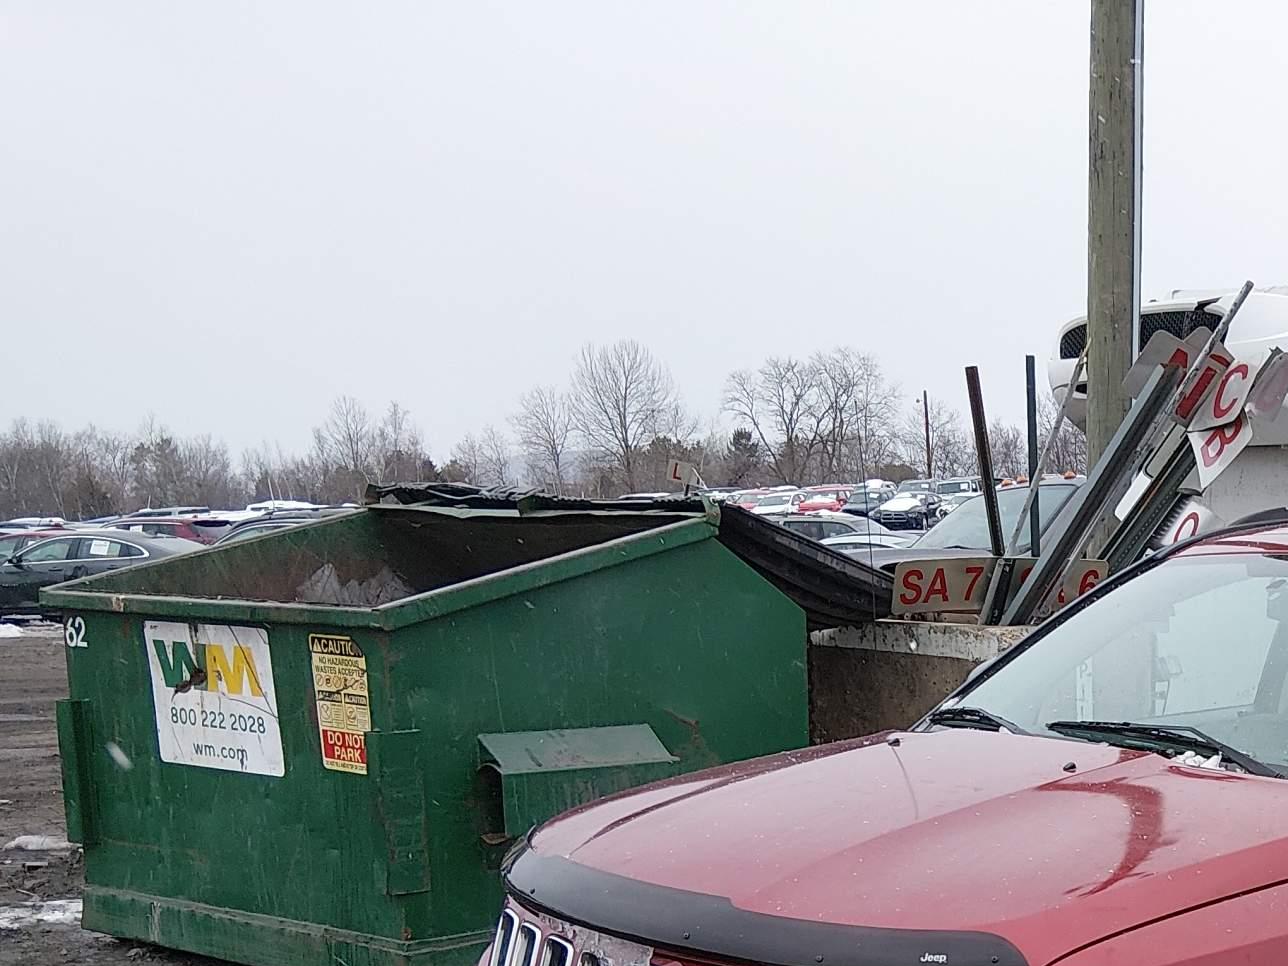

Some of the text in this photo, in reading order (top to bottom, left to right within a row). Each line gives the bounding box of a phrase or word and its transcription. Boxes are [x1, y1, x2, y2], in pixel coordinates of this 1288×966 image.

[1214, 363, 1249, 419] C
[900, 568, 949, 605] SA
[65, 616, 88, 648] 62
[152, 639, 264, 698] WM
[170, 707, 266, 734] 800 222 2028
[193, 742, 248, 761] wm.com
[327, 731, 365, 749] DO NOT
[334, 746, 362, 763] PARK
[920, 952, 948, 964] Jeep
